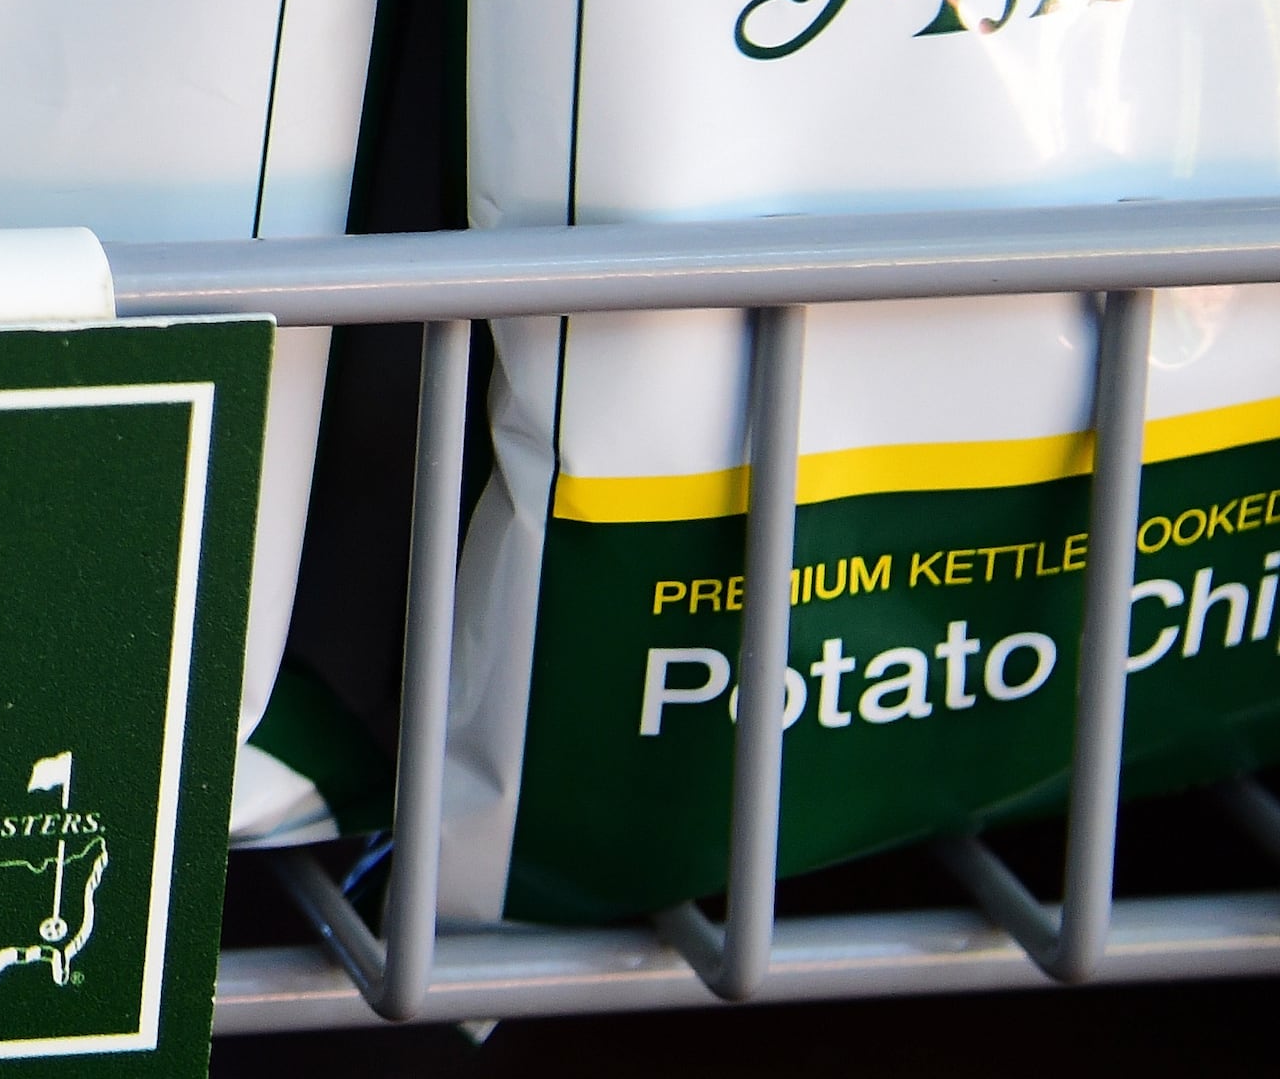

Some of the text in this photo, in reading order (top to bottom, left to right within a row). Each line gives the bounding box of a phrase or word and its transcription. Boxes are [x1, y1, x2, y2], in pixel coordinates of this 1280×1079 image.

[652, 488, 1280, 615] PREIUM KETTLE OOKE
[1125, 548, 1280, 673] Chi
